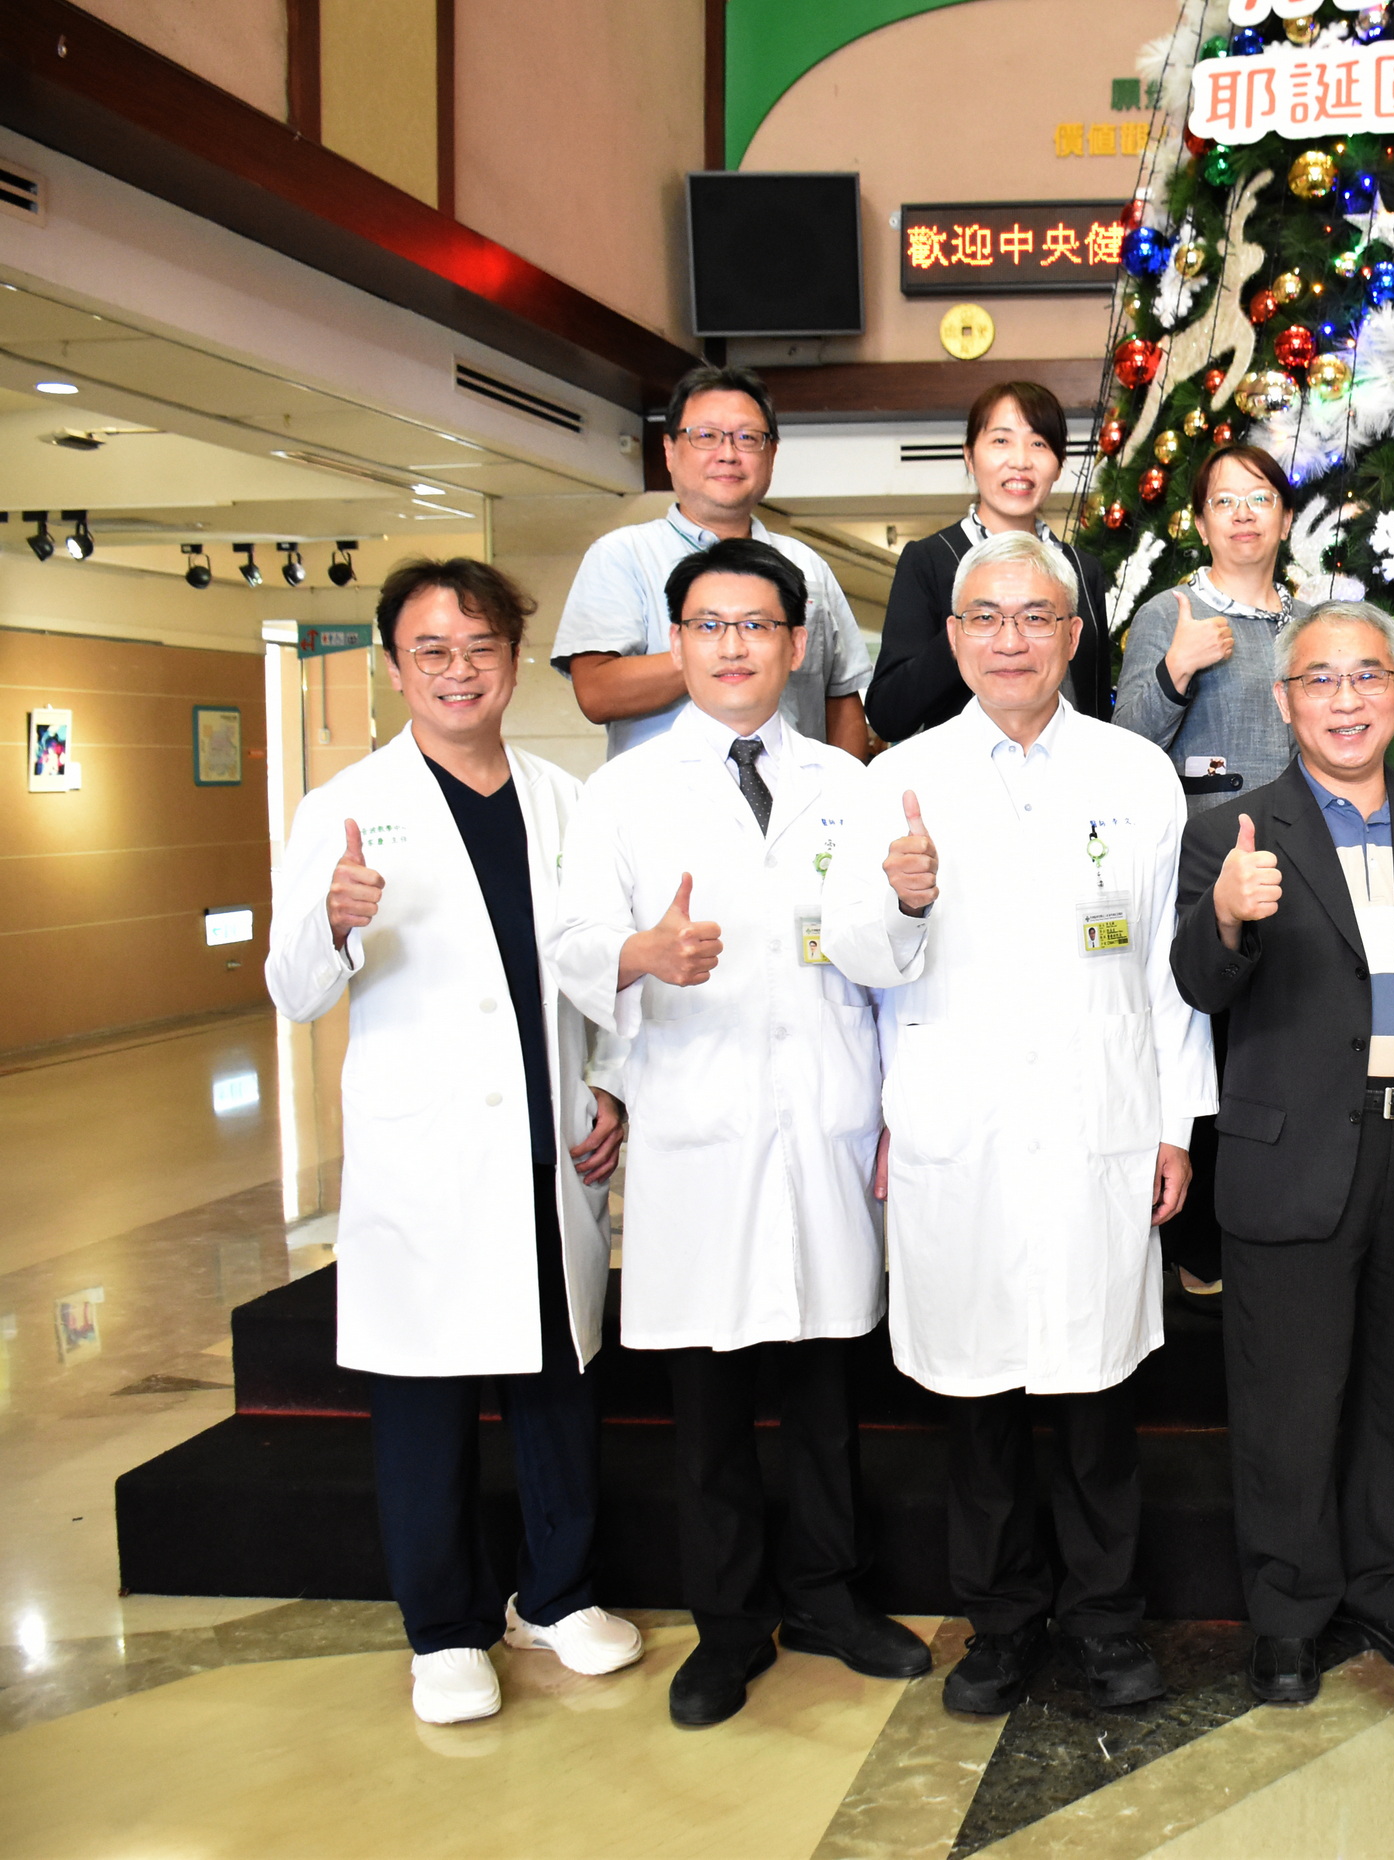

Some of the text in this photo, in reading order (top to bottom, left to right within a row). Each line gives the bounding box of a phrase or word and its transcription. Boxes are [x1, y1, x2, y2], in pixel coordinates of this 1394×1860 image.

[907, 221, 1127, 269] 歡迎中央健
